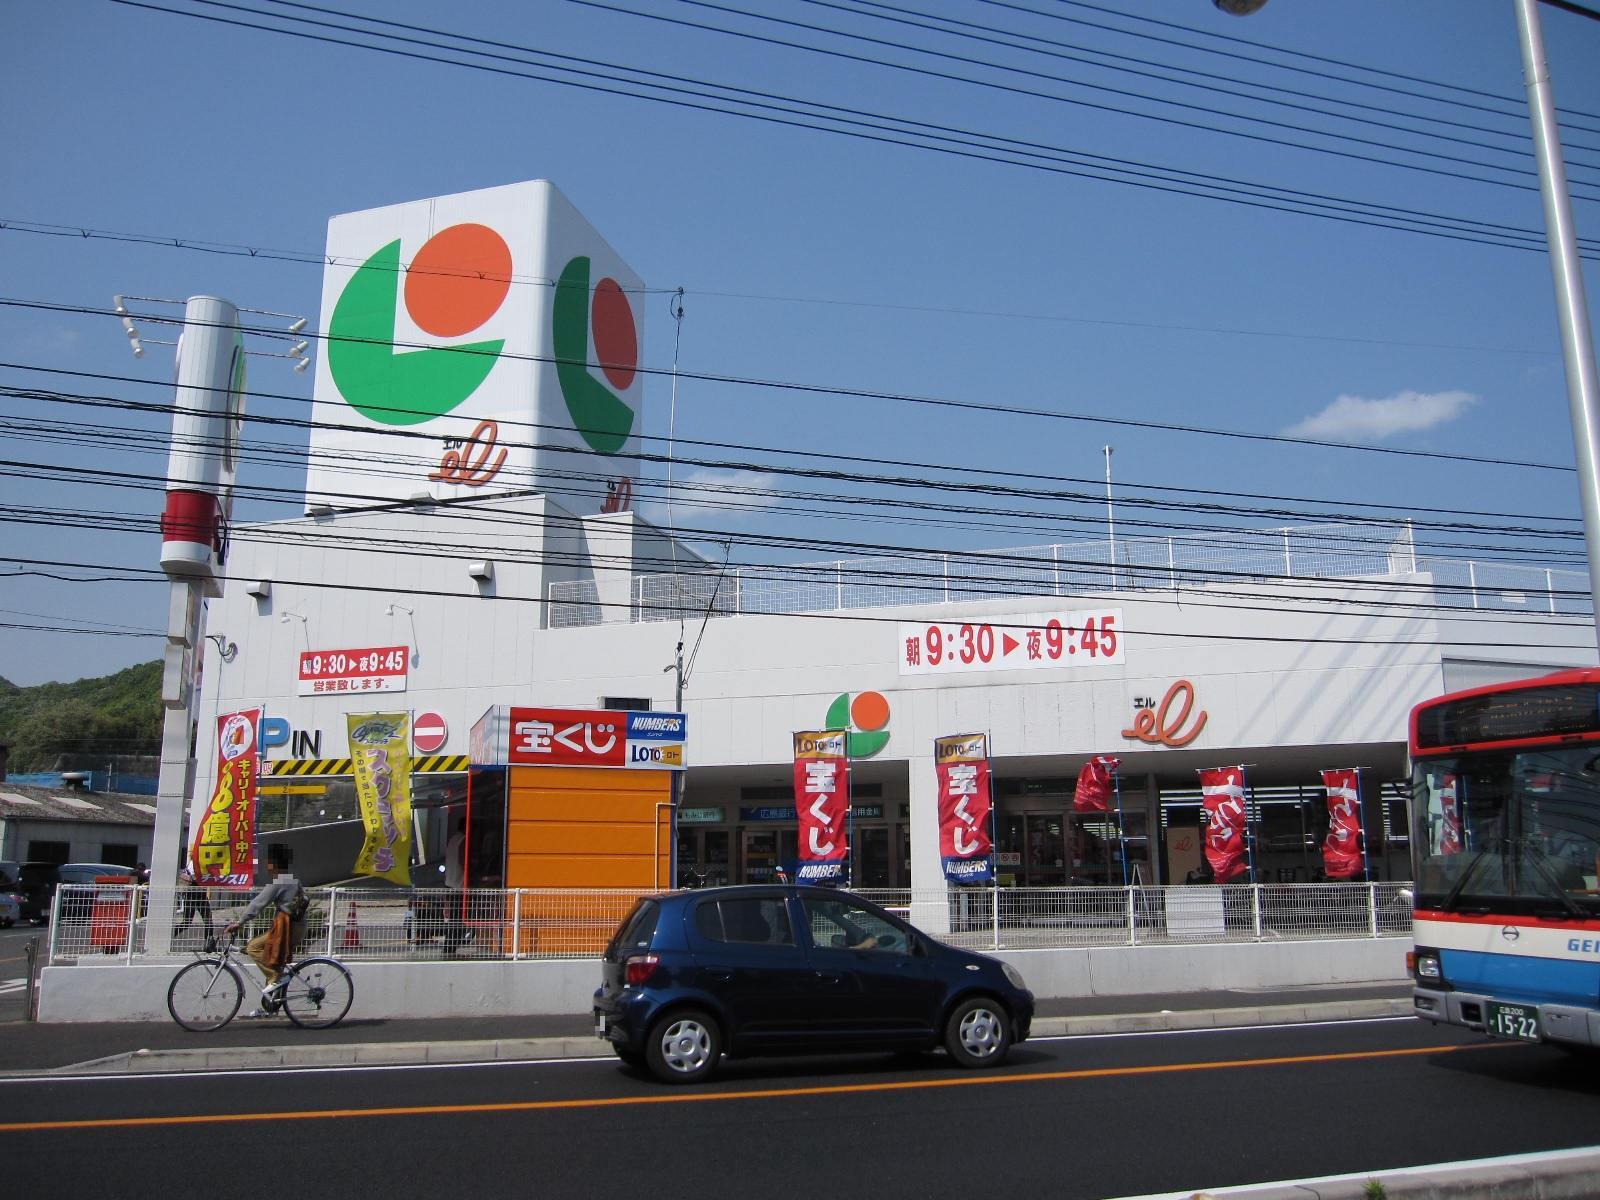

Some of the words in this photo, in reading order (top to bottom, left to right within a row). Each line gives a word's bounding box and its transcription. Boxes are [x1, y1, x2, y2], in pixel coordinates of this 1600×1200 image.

[1133, 697, 1156, 709] エル
[515, 719, 617, 754] 宝くじ
[631, 716, 682, 732] NUMBERS
[259, 716, 291, 759] P
[291, 729, 322, 759] IN
[631, 745, 662, 762] LOTO
[804, 760, 836, 856] 宝くじ
[947, 764, 979, 856] 宝くじ
[946, 859, 988, 874] NUMBERS
